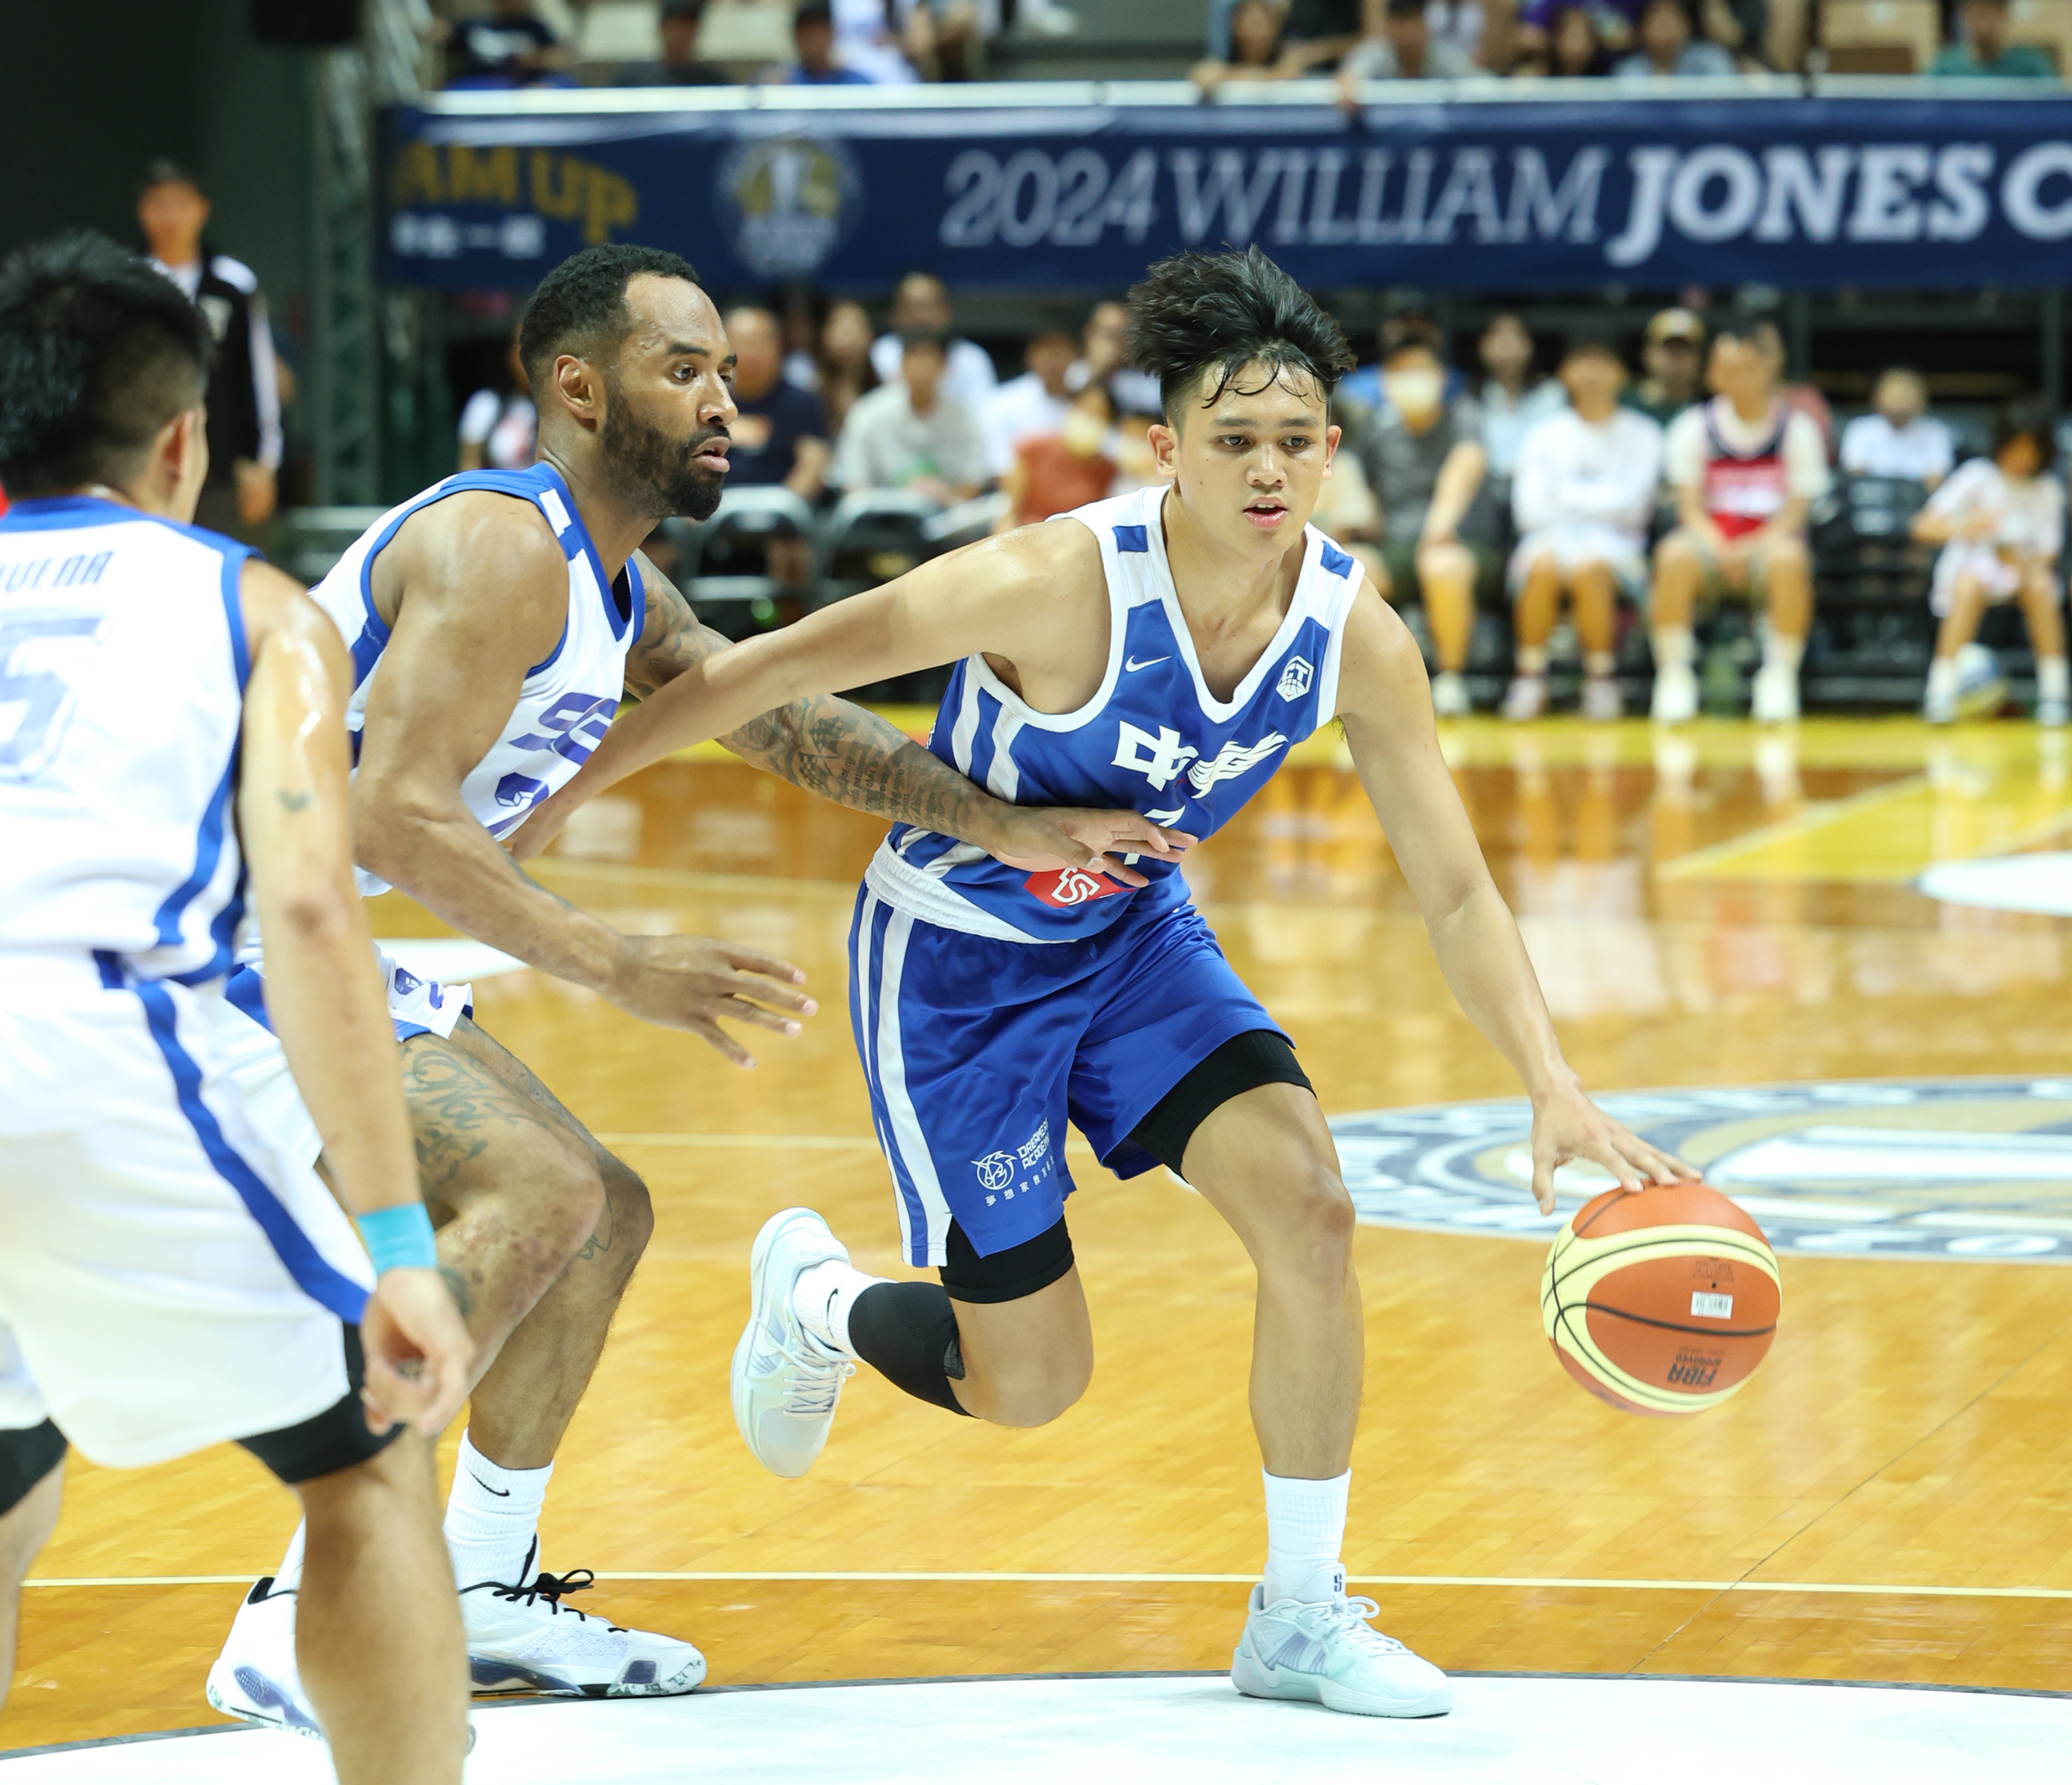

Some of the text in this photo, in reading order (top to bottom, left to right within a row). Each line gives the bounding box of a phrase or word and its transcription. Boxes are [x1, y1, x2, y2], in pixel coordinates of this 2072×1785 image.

[940, 146, 1158, 248] 2024
[1170, 144, 1611, 245] WILLIAM
[1603, 141, 1996, 268] JONES
[2001, 139, 2072, 243] C
[1668, 1361, 1718, 1386] FIBA
